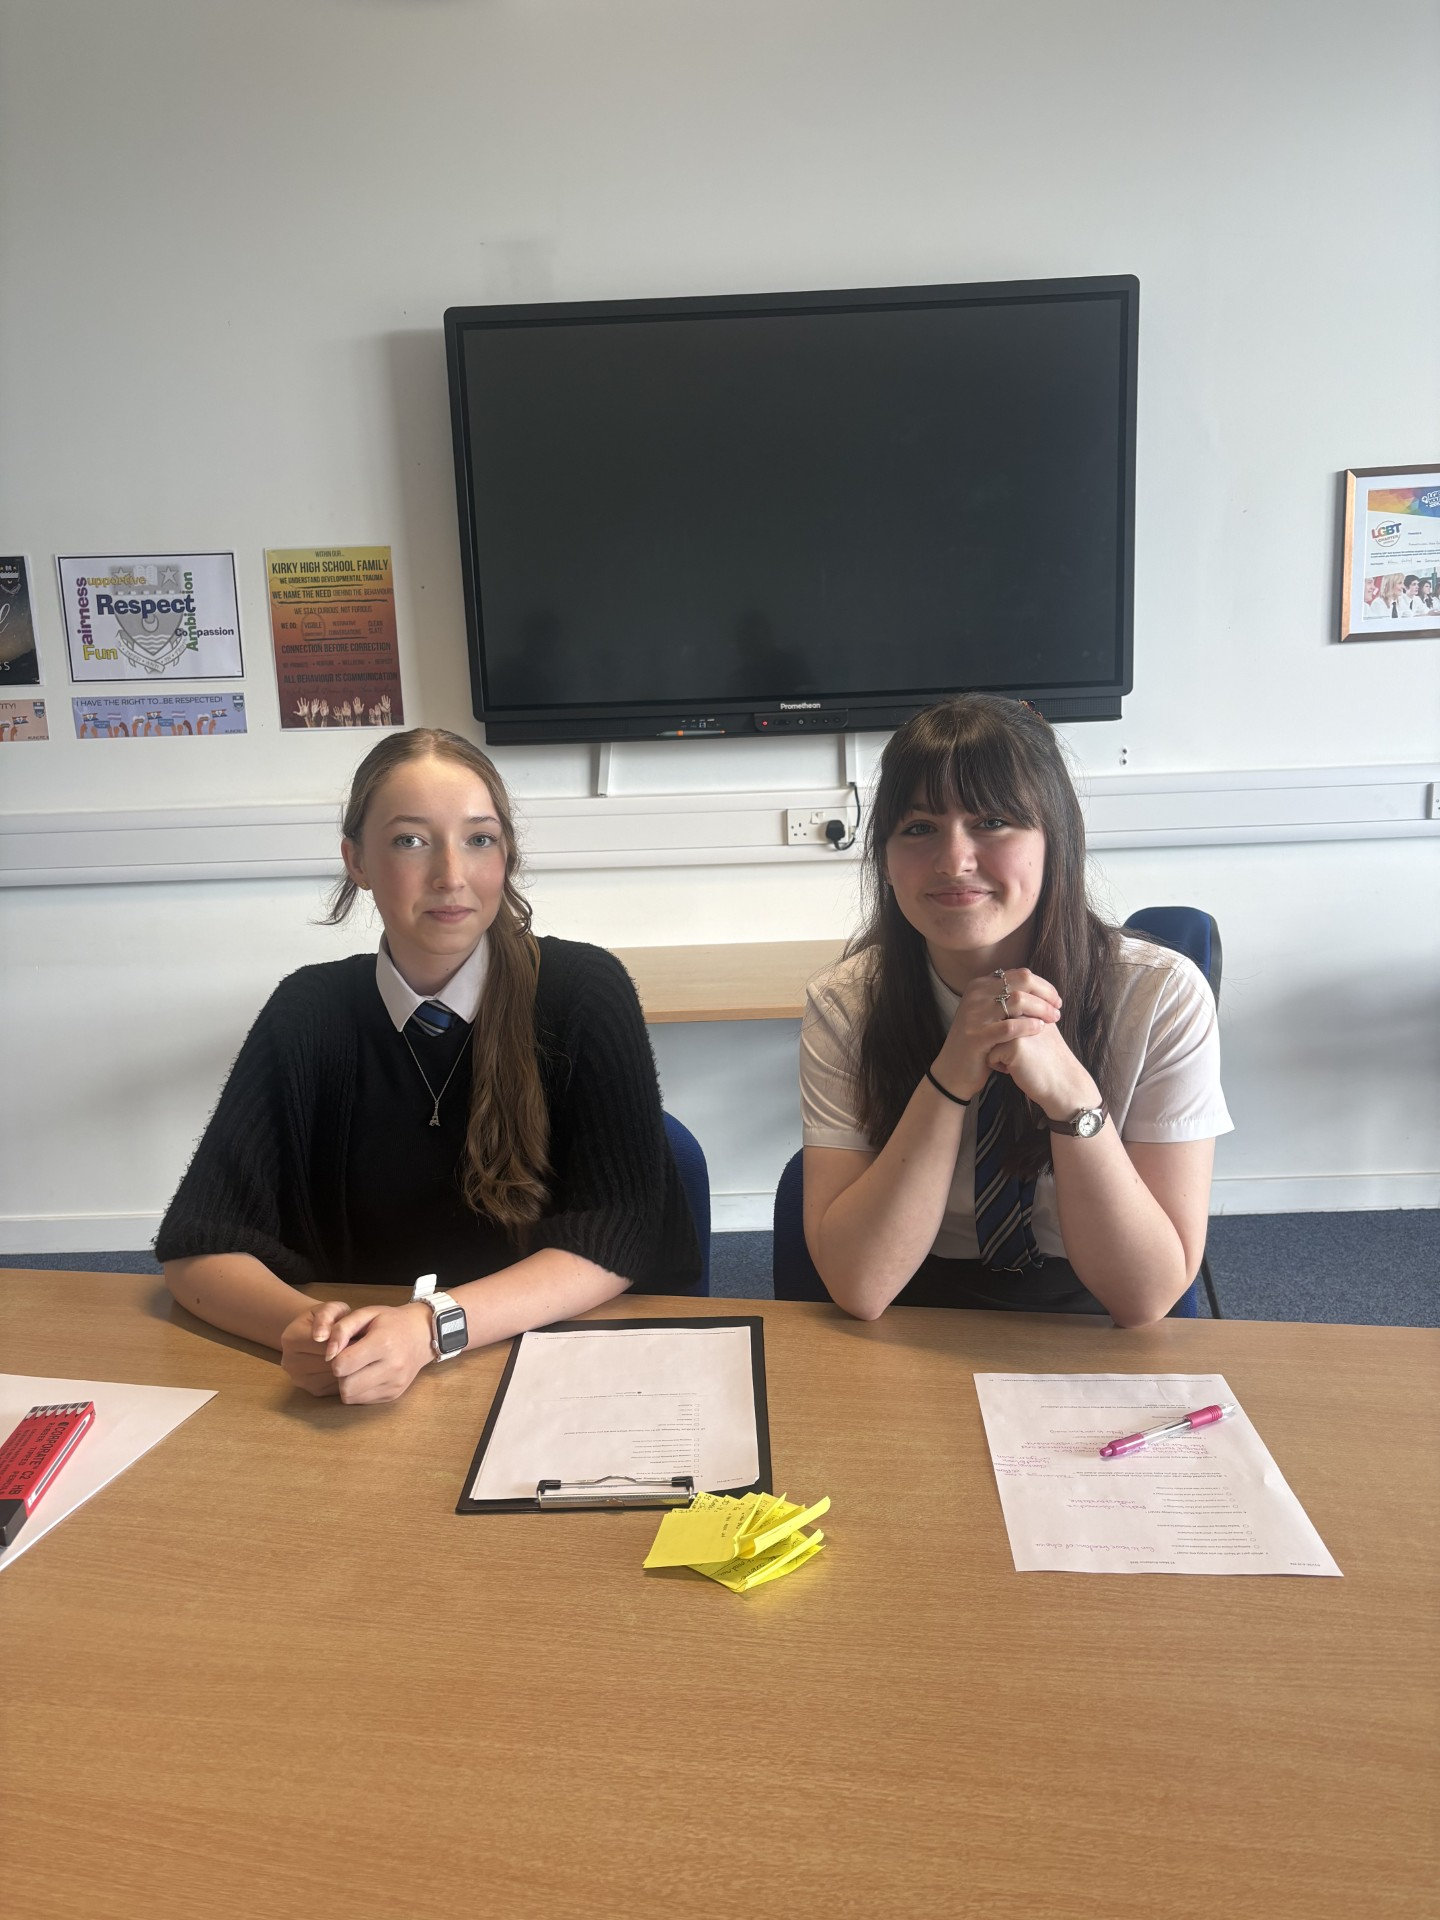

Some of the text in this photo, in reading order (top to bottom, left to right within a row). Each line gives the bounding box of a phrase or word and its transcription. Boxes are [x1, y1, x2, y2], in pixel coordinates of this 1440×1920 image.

[1372, 522, 1402, 538] LGBT
[272, 560, 388, 574] KIRKY HIGH SCHOOL FAMILY
[288, 576, 320, 584] UNDERSTAND
[321, 575, 362, 583] DEVELOPMENTAL
[272, 591, 282, 599] WE
[283, 590, 301, 599] NAME
[302, 590, 314, 598] THE
[315, 590, 331, 598] NEED
[96, 594, 196, 618] Respect
[83, 644, 118, 661] Fun
[282, 642, 391, 654] CONNECTION BEFORE CORRECTION
[284, 672, 398, 684] ALL BEHAVIOUR IS COMMUNICATION
[175, 696, 223, 704] RESPECTED!
[780, 702, 821, 710] Promethean
[19, 1470, 34, 1480] C2
[8, 1484, 24, 1495] HB
